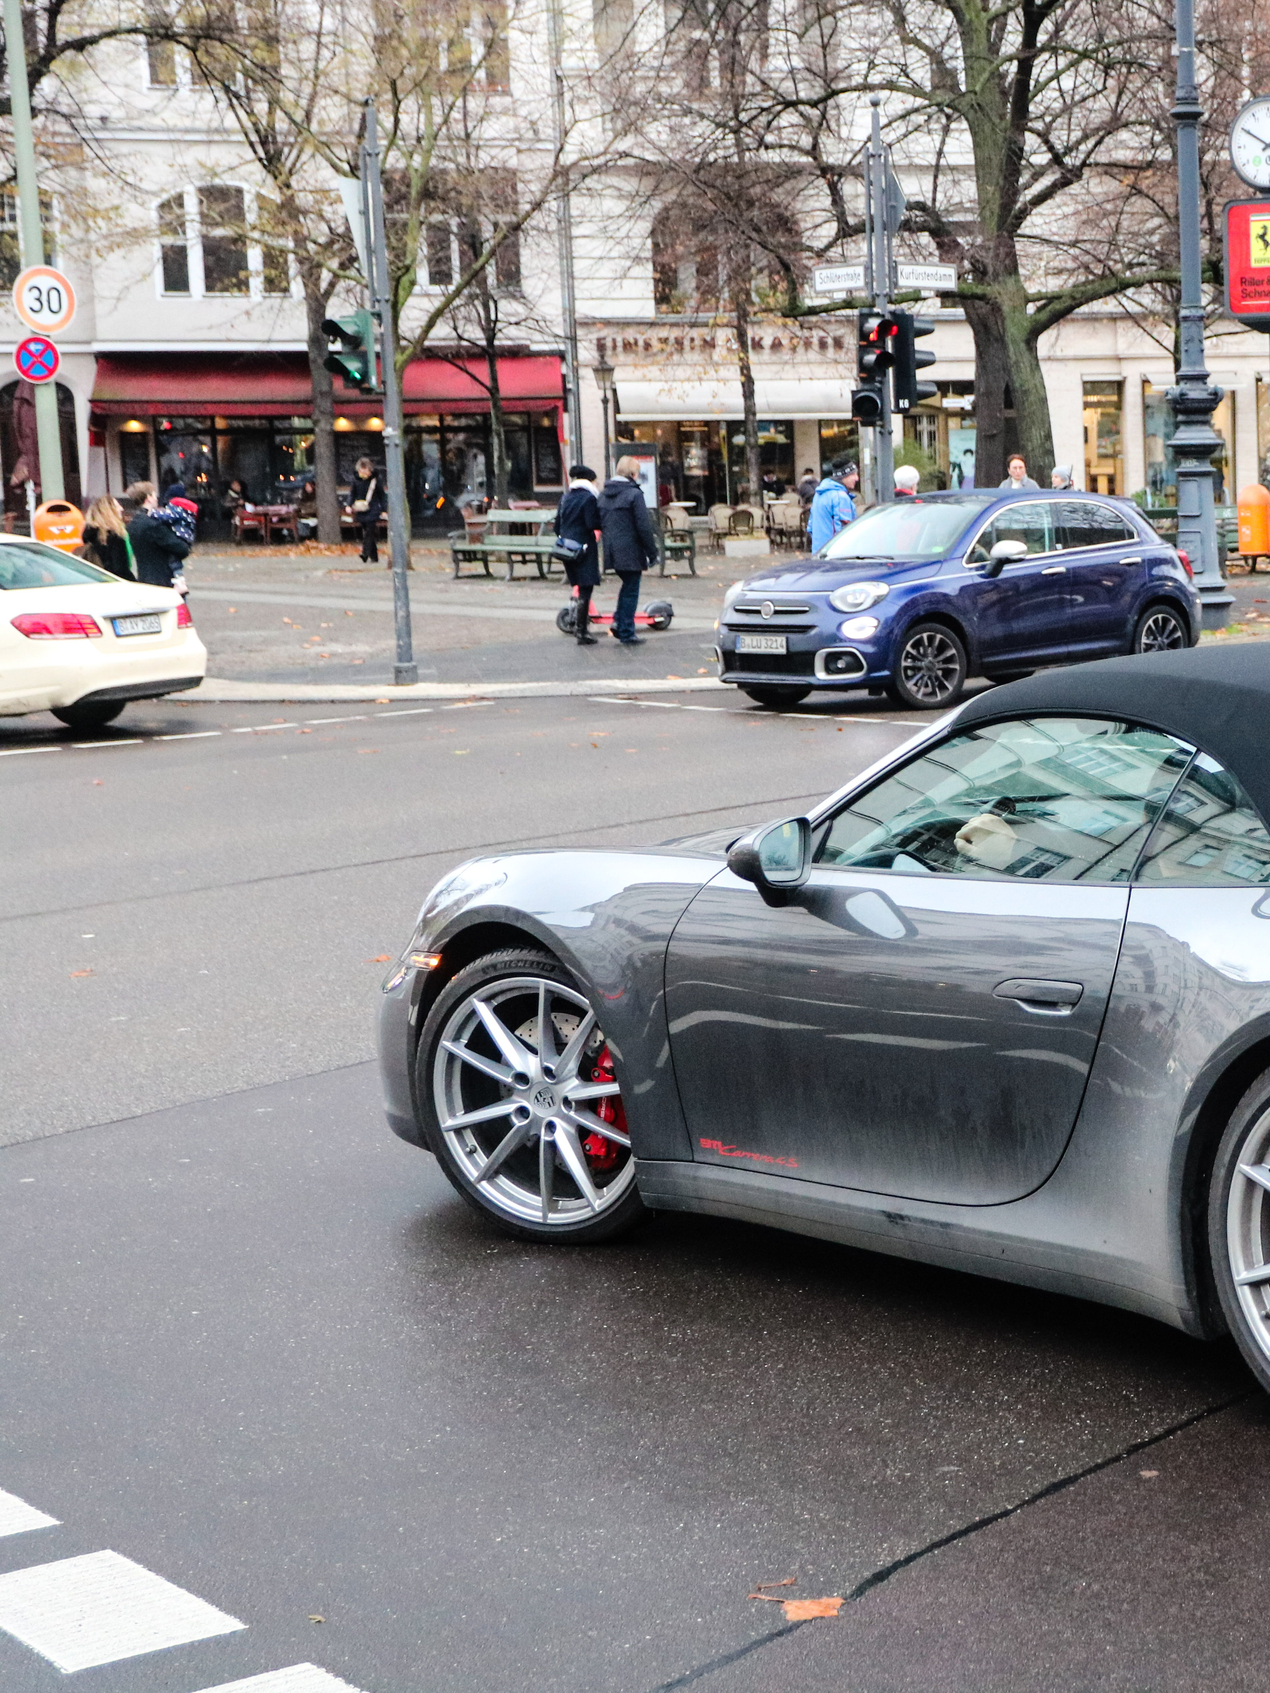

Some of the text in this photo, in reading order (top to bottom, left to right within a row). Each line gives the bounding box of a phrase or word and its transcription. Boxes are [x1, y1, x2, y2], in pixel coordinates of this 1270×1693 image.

[818, 271, 862, 286] Schlüterstraße
[900, 267, 953, 283] Kurfürstendamm
[28, 285, 62, 314] 30
[899, 398, 909, 409] K6
[740, 637, 784, 650] B LU 3214
[495, 960, 553, 971] MICHELIN
